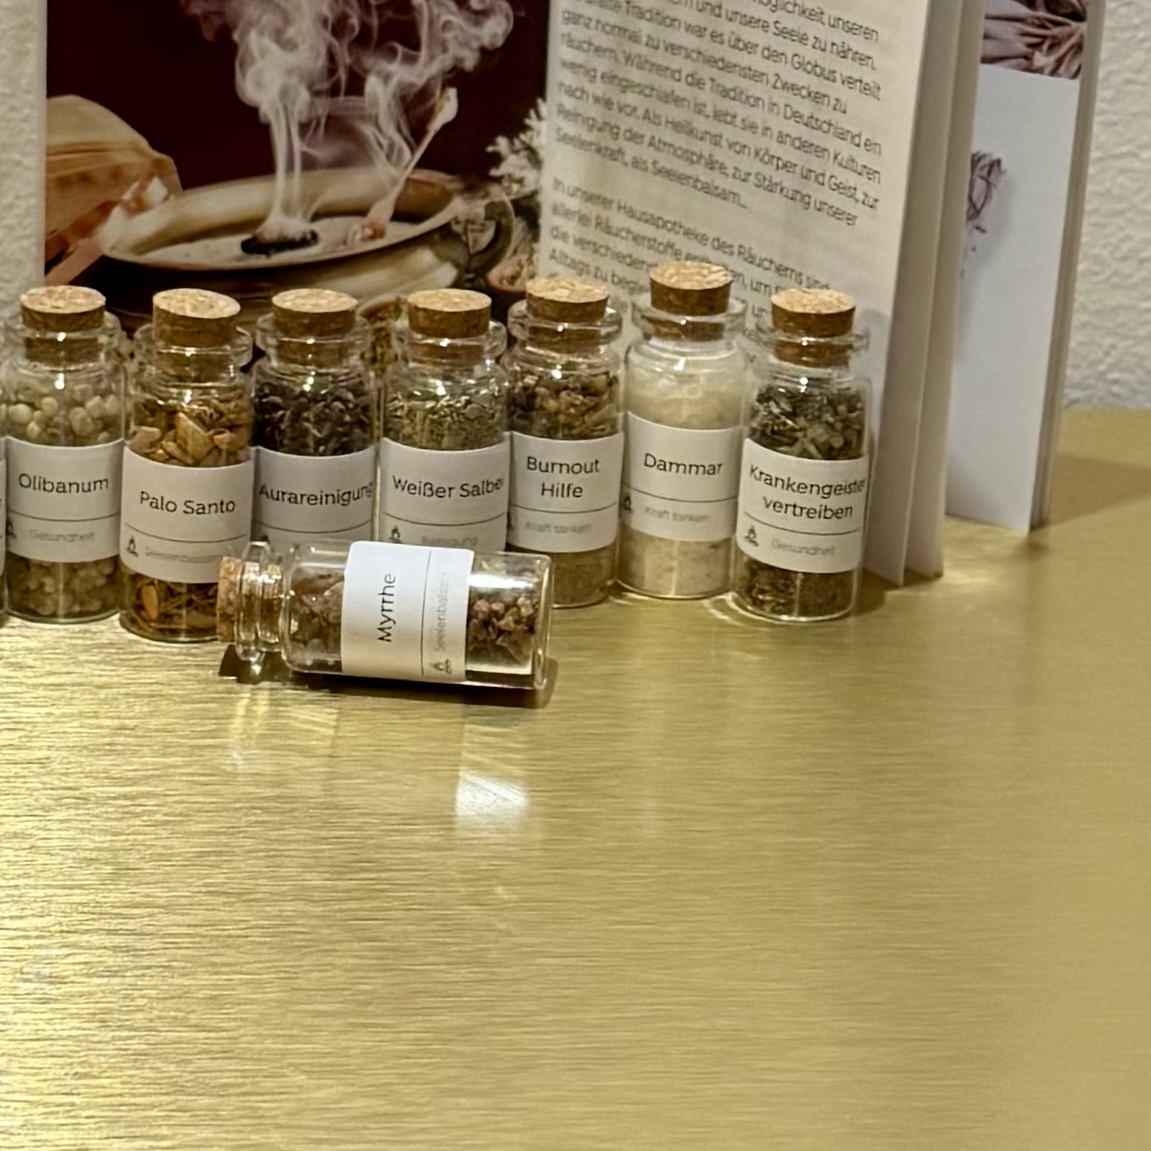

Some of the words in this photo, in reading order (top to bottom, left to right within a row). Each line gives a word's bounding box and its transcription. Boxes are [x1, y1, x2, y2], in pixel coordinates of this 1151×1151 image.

[695, 0, 722, 18] und
[725, 8, 770, 33] unsere
[772, 19, 809, 46] Seele
[811, 35, 827, 52] zu
[827, 15, 878, 41] unseren
[562, 9, 593, 29] ganz
[644, 34, 660, 50] zu
[662, 39, 769, 85] verschiedensten
[771, 72, 830, 106] Zwecken
[832, 97, 847, 114] zu
[683, 20, 707, 38] war
[709, 29, 724, 45] es
[727, 30, 759, 54] über
[760, 44, 788, 65] den
[790, 52, 836, 83] Globus
[621, 49, 682, 82] Während
[684, 71, 705, 90] die
[708, 76, 765, 110] Tradition
[767, 96, 780, 116] in
[782, 103, 861, 148] Deutschland
[863, 137, 881, 155] ein
[558, 81, 589, 102] nach
[591, 92, 614, 111] wie
[642, 107, 662, 126] Als
[725, 138, 751, 158] von
[753, 147, 798, 174] Körper
[800, 165, 825, 186] und
[861, 192, 879, 209] zur
[739, 117, 758, 134] sie
[761, 125, 773, 139] in
[775, 130, 830, 161] anderen
[832, 150, 880, 184] Kulturen
[556, 102, 620, 141] Reinigung
[622, 127, 645, 145] der
[731, 165, 751, 183] zur
[753, 171, 811, 210] Stärkung
[813, 198, 857, 226] unserer
[630, 155, 648, 172] als
[526, 456, 600, 475] Burnout
[644, 453, 724, 476] Dammar
[19, 473, 109, 494] Olibanum
[392, 475, 456, 498] Weißer
[459, 477, 505, 498] Salbe
[541, 483, 583, 498] Hilfe
[140, 491, 177, 513] Palo
[183, 500, 236, 515] Santo
[762, 496, 853, 520] vertreiben
[377, 573, 397, 643] Myrrhe
